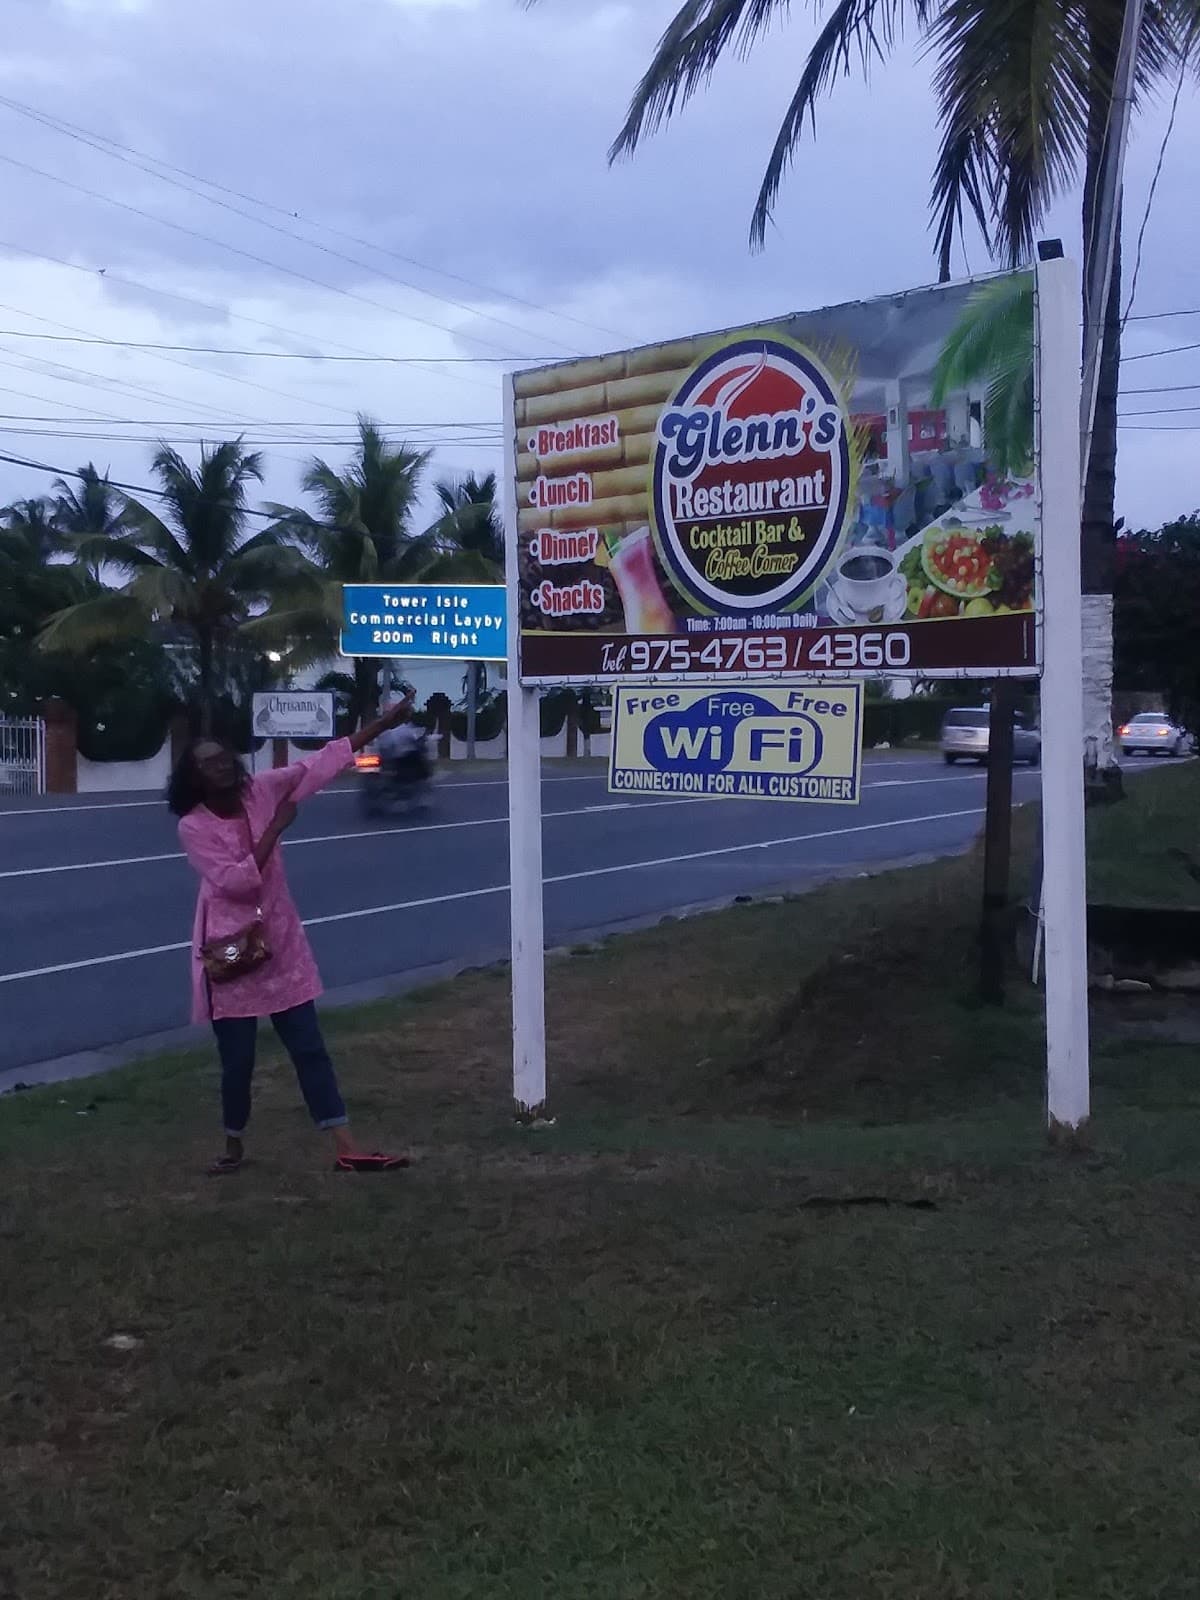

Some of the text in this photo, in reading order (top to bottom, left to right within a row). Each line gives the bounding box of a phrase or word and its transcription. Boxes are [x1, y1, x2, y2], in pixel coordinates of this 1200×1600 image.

[537, 419, 616, 456] Breakfast
[661, 398, 837, 478] Glenn's
[538, 476, 590, 507] Lunch
[675, 469, 826, 519] Restaurant
[540, 532, 597, 561] Dinner
[689, 515, 805, 549] Cocktail Bar &
[705, 543, 799, 581] Coffee Corner
[382, 594, 469, 608] Tower Isle
[541, 583, 602, 612] Snacks
[350, 612, 503, 630] Commercial Layby
[686, 617, 712, 632] Time:
[792, 612, 818, 629] Daily
[372, 630, 478, 648] 200m Right
[626, 691, 848, 717] Free Free Free
[614, 769, 853, 799] CONNECTION FOR ALL CUSTOMER
